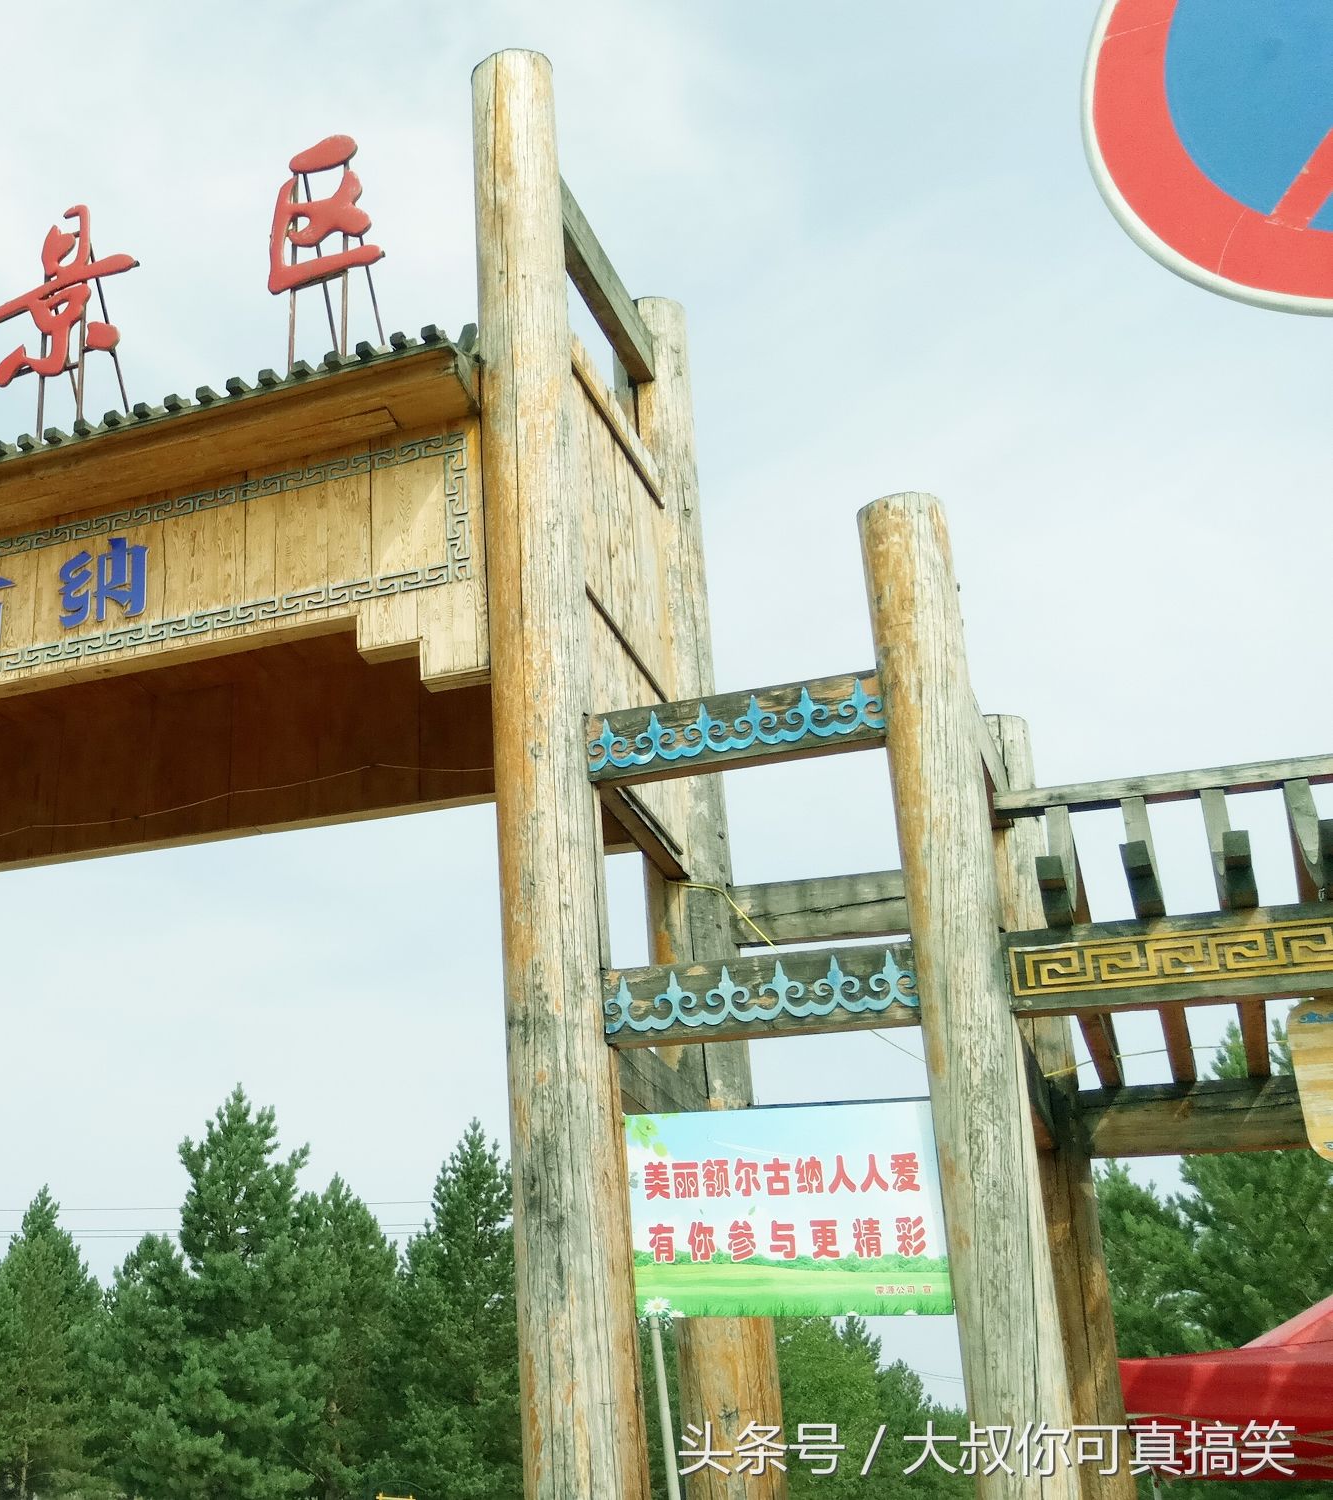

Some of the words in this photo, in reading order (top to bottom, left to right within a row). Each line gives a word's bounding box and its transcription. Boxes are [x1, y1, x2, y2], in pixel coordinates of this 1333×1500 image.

[644, 1152, 921, 1201] 美丽额尔古纳人人爱
[648, 1215, 927, 1263] 有你参与更精彩
